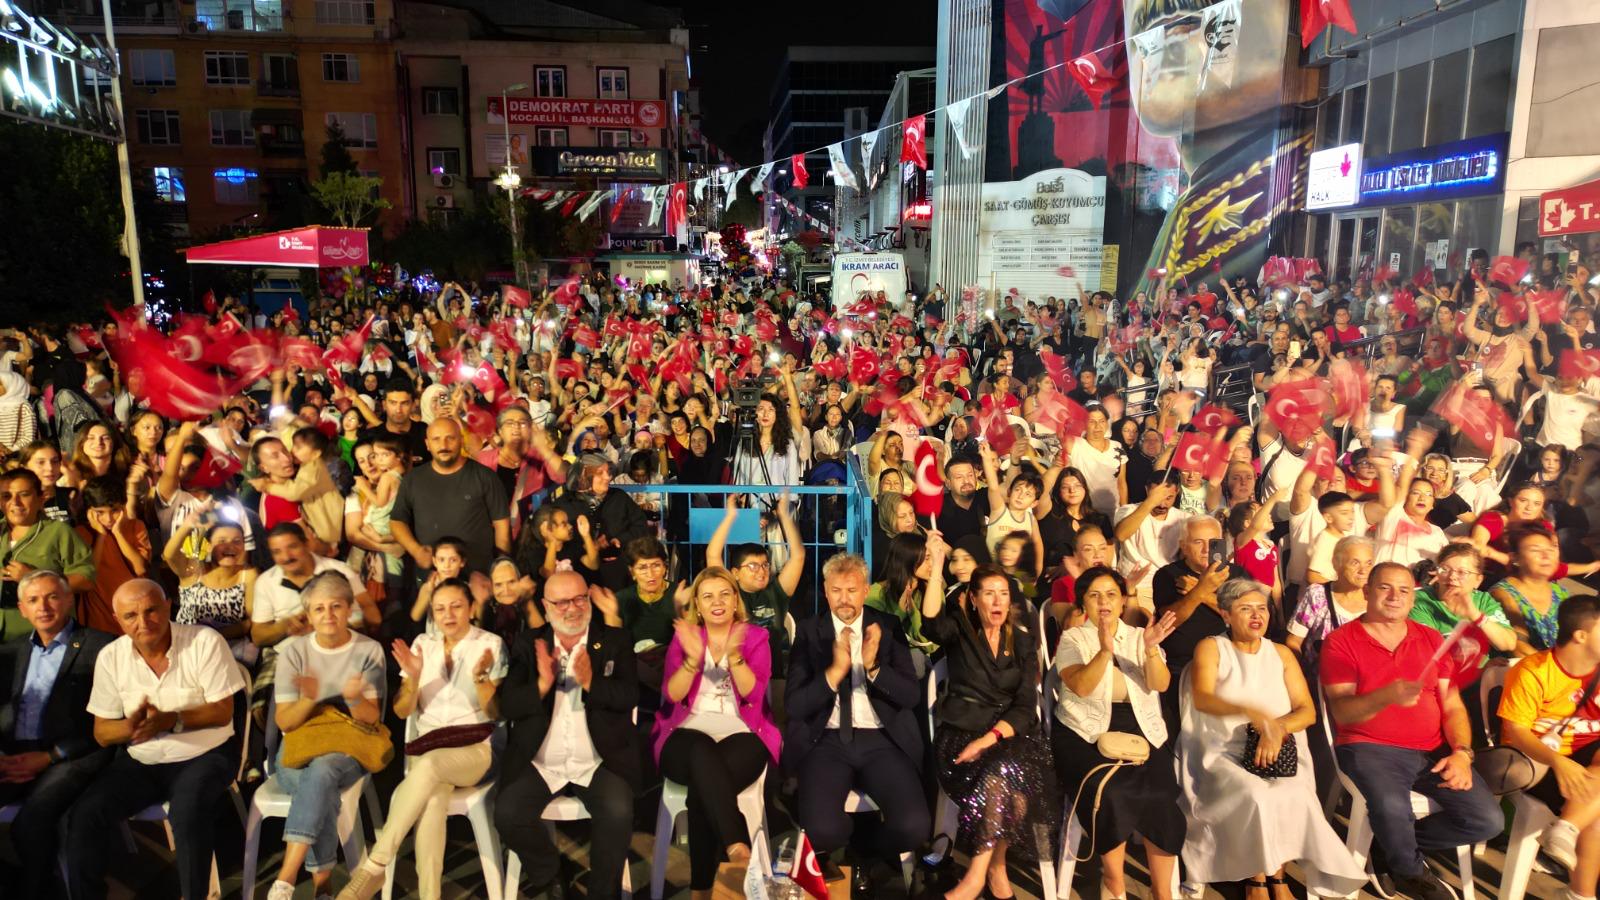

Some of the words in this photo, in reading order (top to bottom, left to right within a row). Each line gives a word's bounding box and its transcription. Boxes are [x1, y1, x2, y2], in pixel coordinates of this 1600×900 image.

[509, 101, 589, 113] DEMOKRAT
[593, 102, 635, 114] PARTİ
[510, 113, 556, 122] KOCAELİ
[559, 114, 569, 123] İL
[571, 115, 635, 125] BAŞKANLIĞI
[841, 262, 870, 270] İKRAM
[872, 262, 899, 270] ARACI
